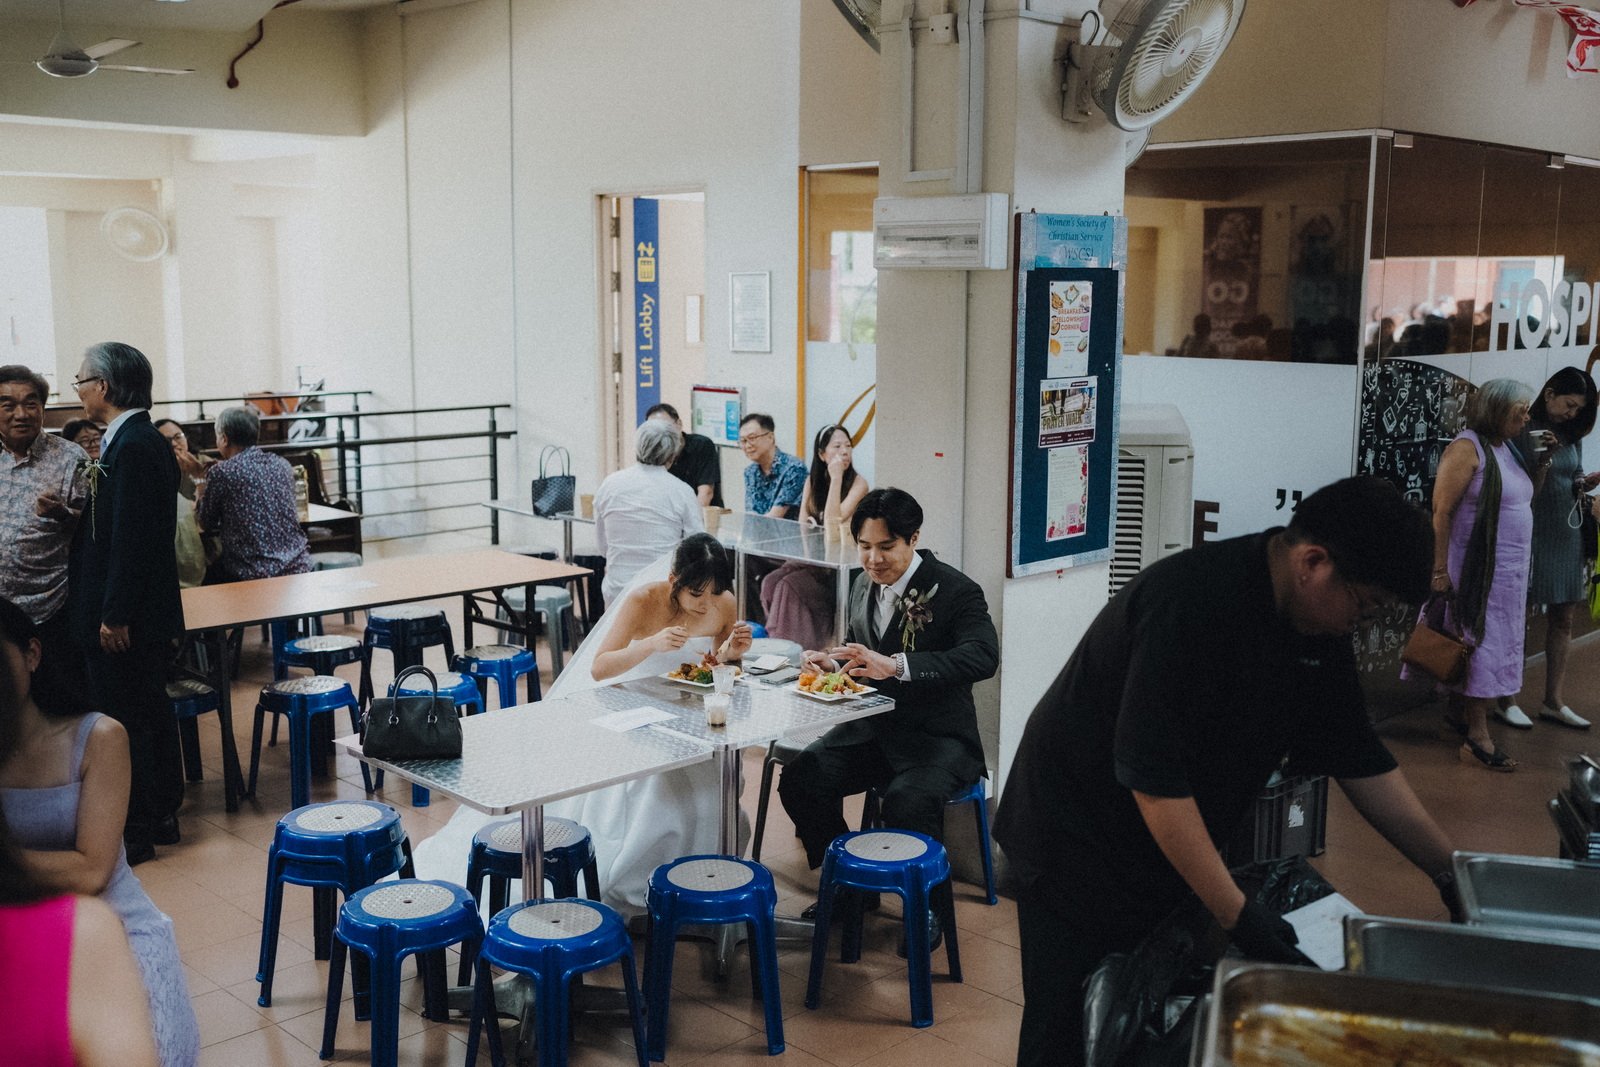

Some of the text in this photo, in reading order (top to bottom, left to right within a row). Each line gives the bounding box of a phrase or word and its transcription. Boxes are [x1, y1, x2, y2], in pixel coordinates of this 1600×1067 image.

[1047, 216, 1108, 231] Women's Society of
[1048, 230, 1104, 241] Christian Service
[1490, 279, 1600, 352] HOSPI
[640, 293, 655, 388] Lift Lobby
[1042, 410, 1082, 431] PRAYER WALK
